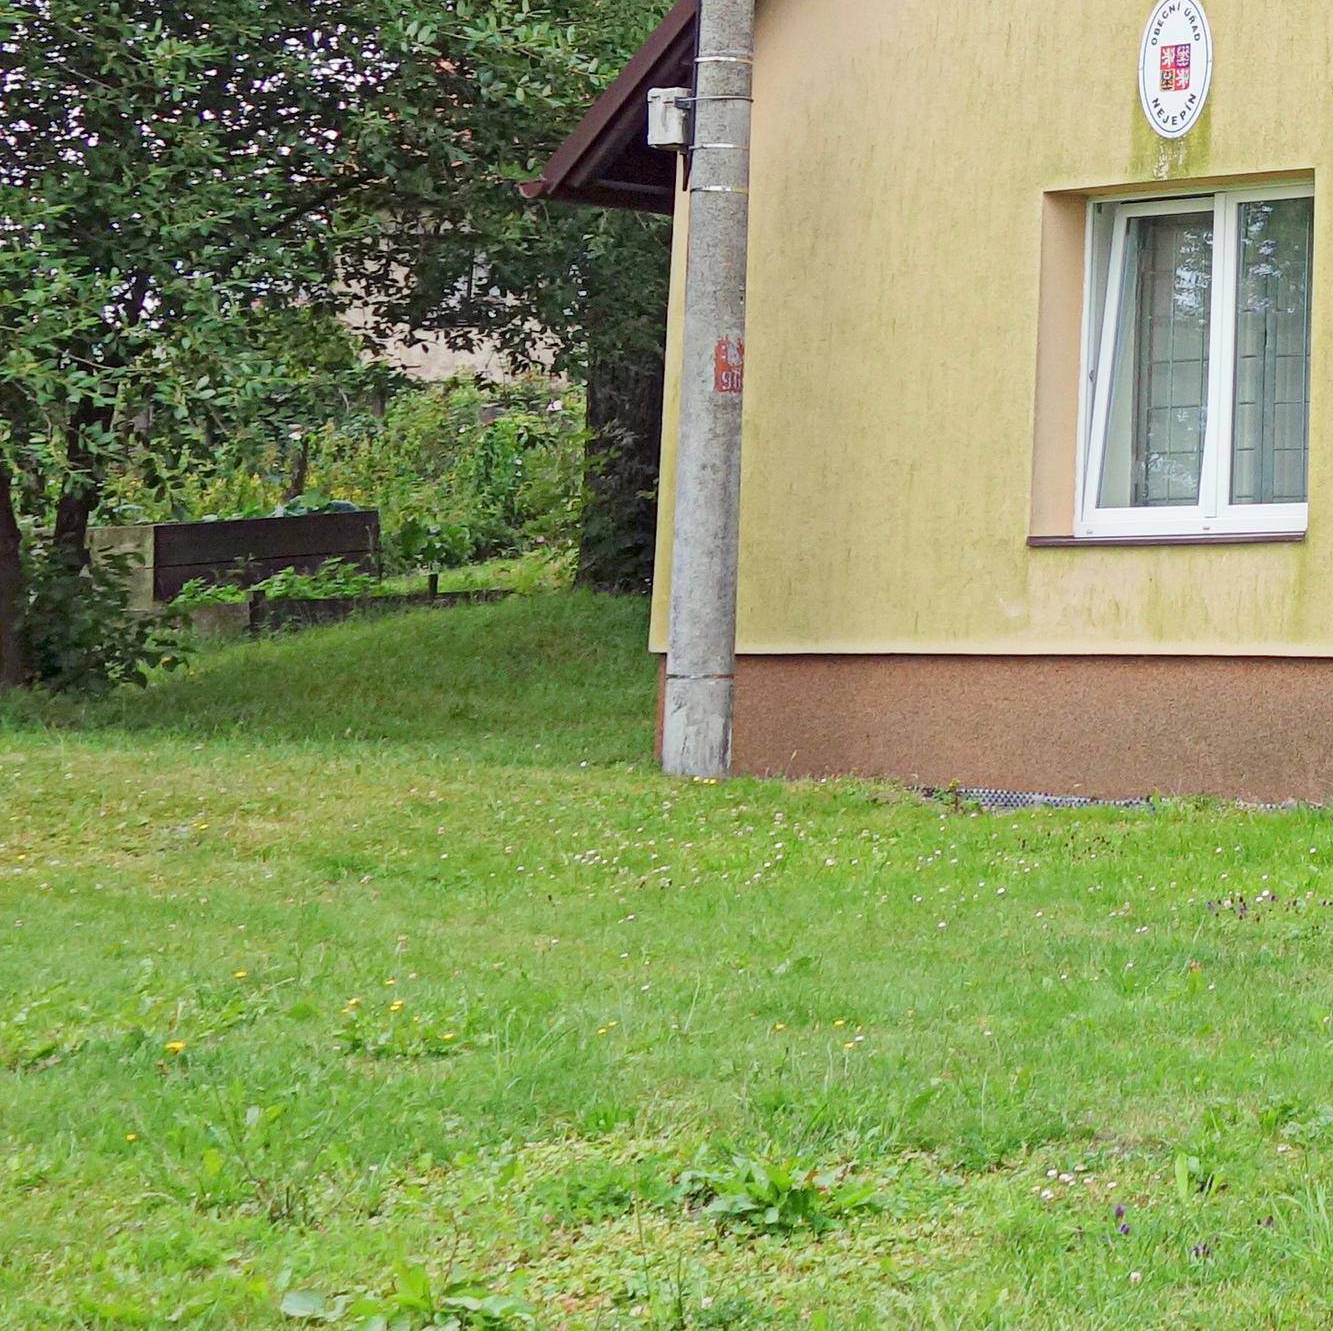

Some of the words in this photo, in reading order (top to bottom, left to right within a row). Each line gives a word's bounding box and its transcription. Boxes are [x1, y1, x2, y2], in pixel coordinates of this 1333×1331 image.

[1151, 1, 1181, 46] OBECNÍ
[1184, 6, 1201, 42] ÚŘAD
[1152, 93, 1197, 126] NEJEPÍN
